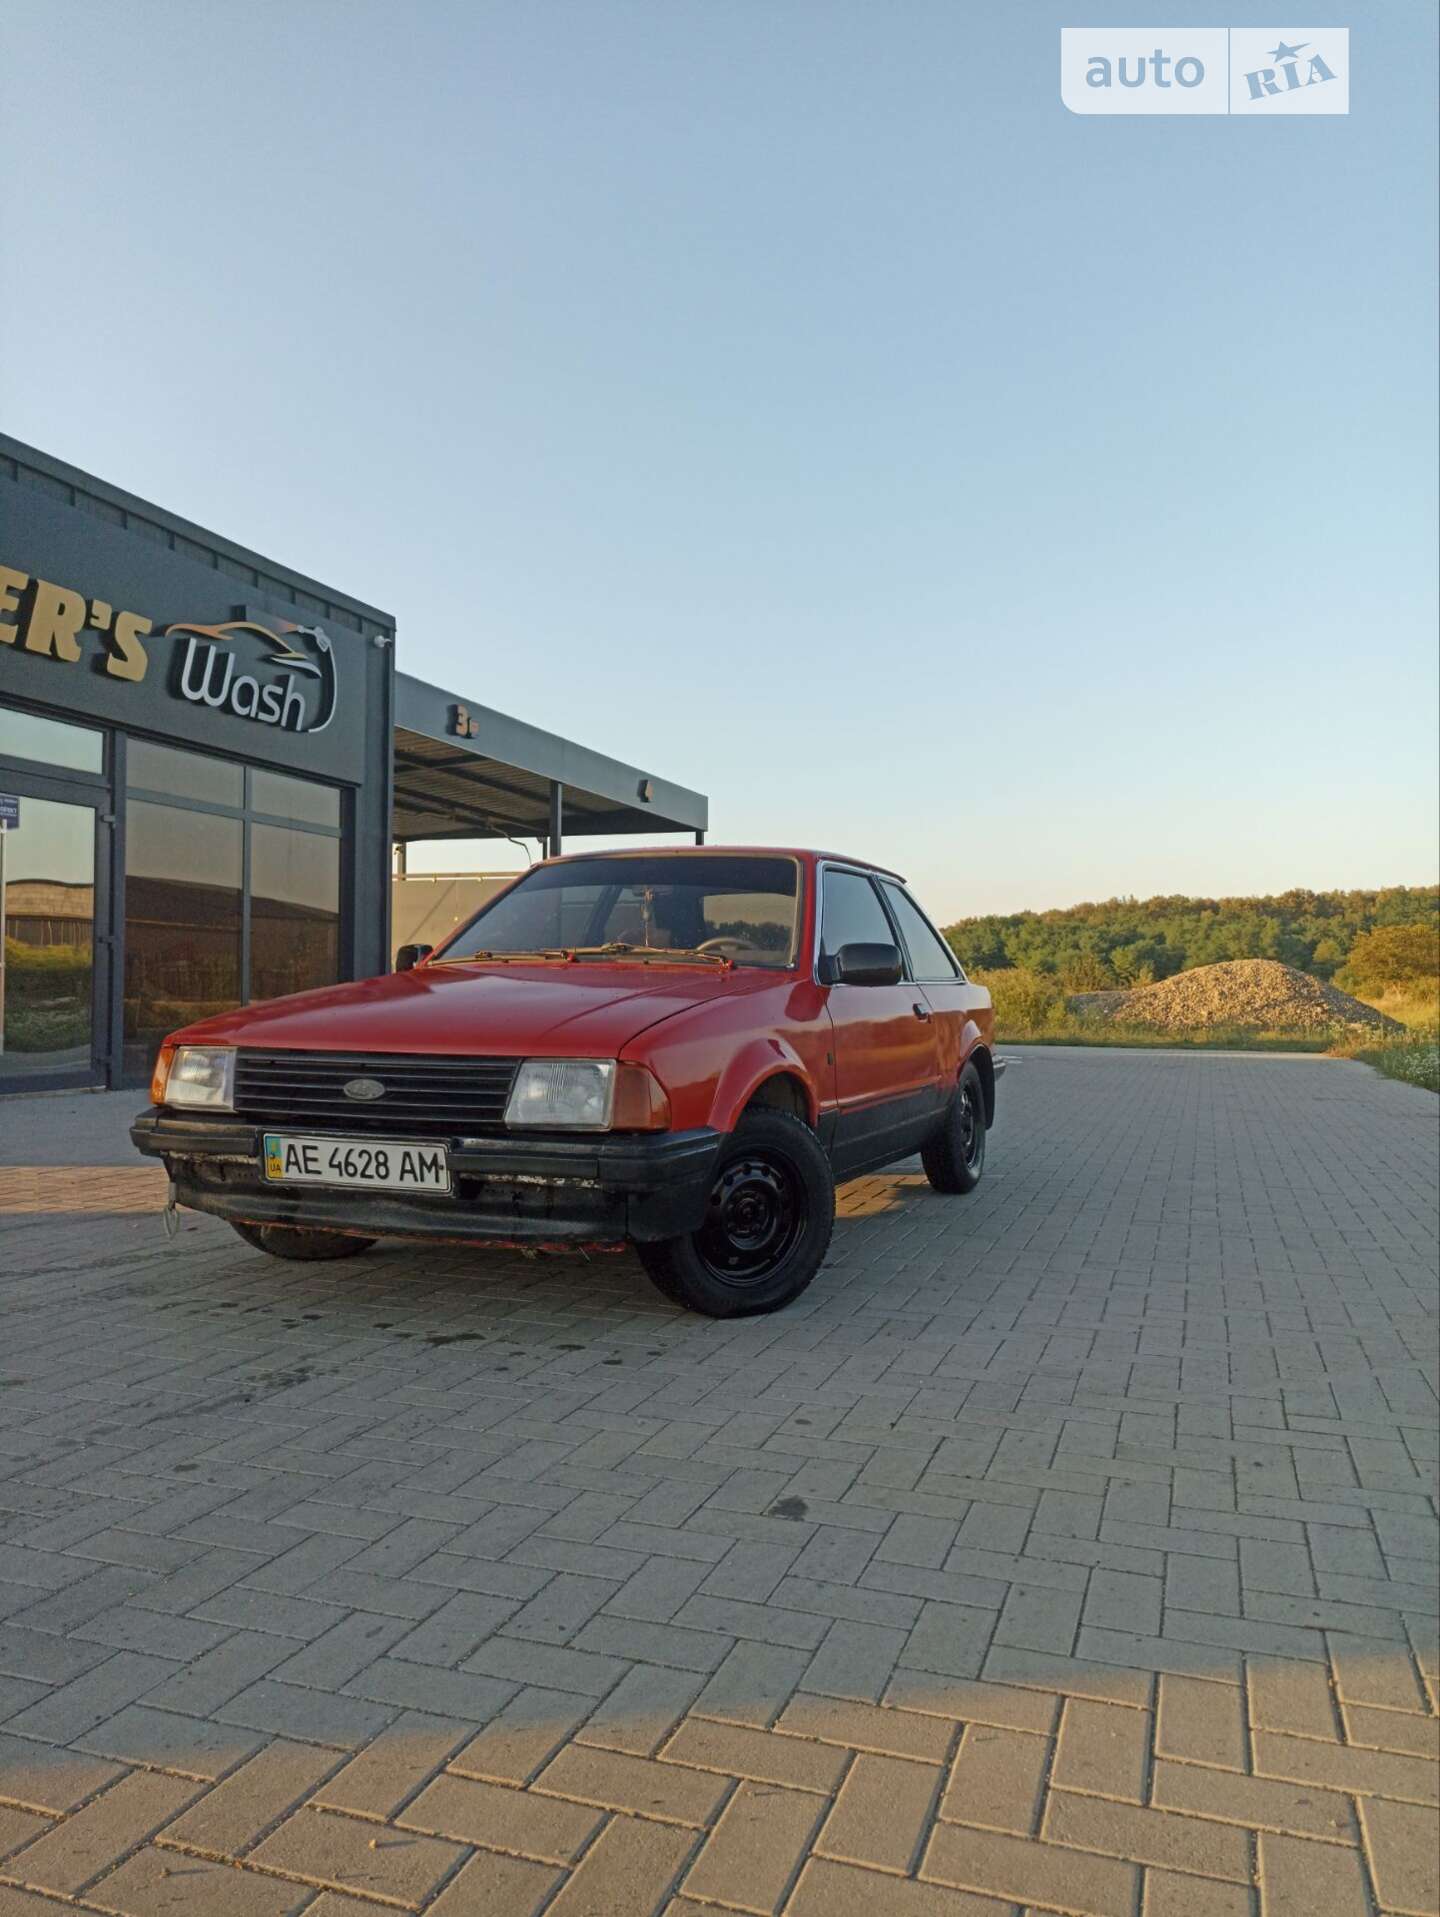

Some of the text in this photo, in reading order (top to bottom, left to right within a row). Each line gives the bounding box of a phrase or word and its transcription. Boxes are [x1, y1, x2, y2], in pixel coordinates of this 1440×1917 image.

[181, 637, 306, 731] Wash
[285, 1143, 440, 1183] AE 4628 AM
